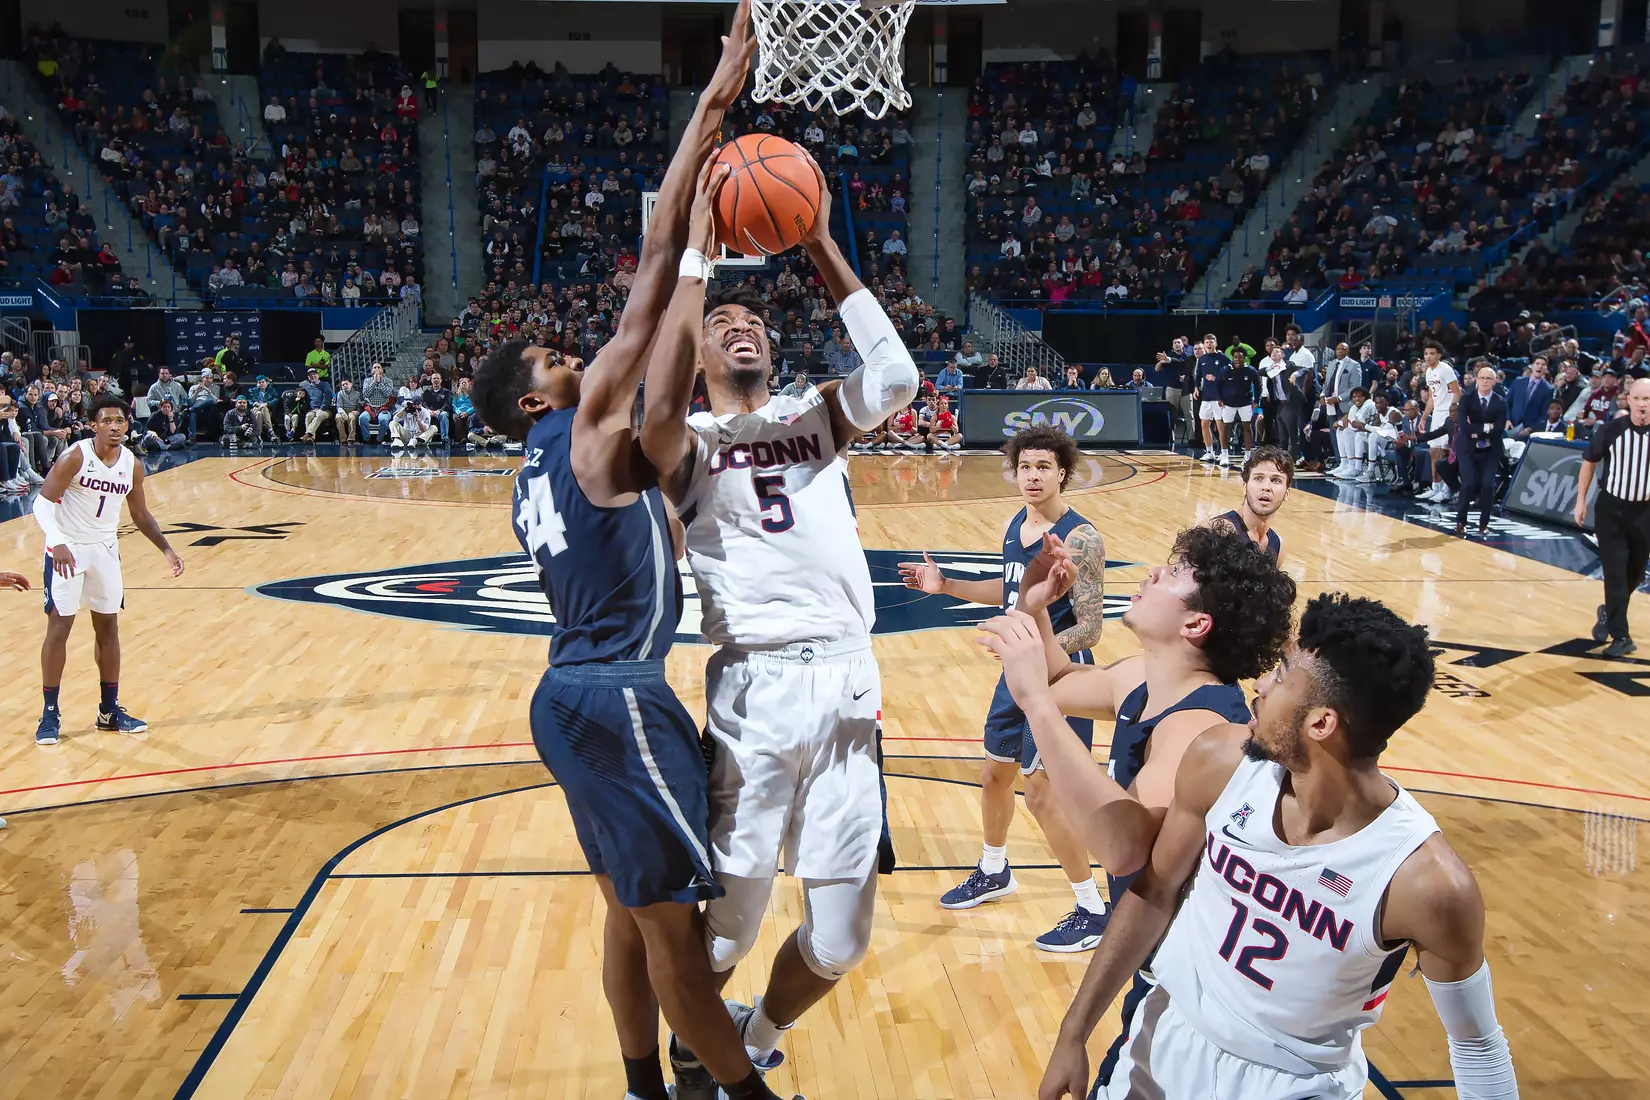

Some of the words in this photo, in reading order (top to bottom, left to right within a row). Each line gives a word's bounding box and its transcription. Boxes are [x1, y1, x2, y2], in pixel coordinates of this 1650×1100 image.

[708, 433, 823, 476] UCONN
[79, 475, 130, 495] UCONN
[95, 495, 107, 518] 1
[752, 474, 796, 534] 5
[1519, 469, 1580, 514] SNY
[1005, 561, 1027, 584] UN
[1207, 831, 1355, 953] UCONN
[1218, 897, 1290, 992] 12
